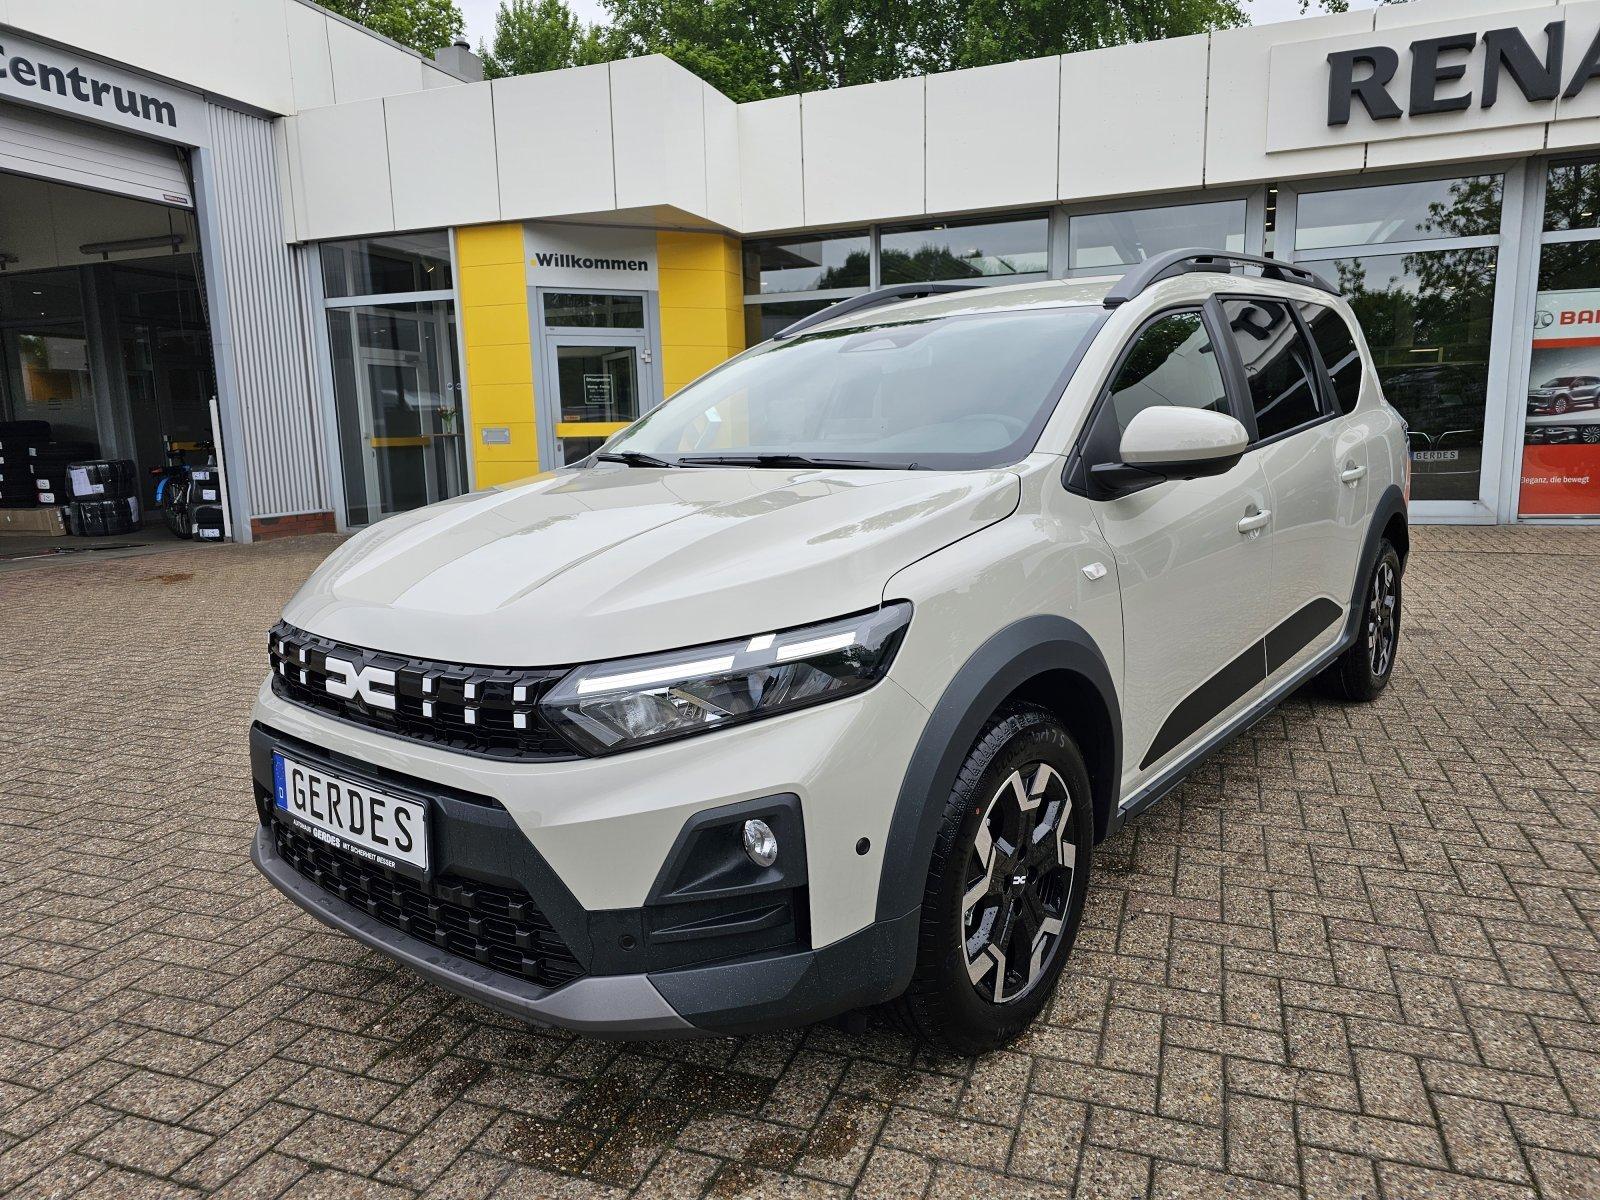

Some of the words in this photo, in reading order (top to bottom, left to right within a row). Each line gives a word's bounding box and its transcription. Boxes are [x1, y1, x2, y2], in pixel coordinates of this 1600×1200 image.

[535, 253, 648, 271] Willkommen
[1416, 451, 1456, 460] GERDES
[1550, 476, 1561, 484] die
[1563, 476, 1589, 485] bewegt
[292, 768, 413, 853] GERDES
[312, 827, 341, 848] GERDES
